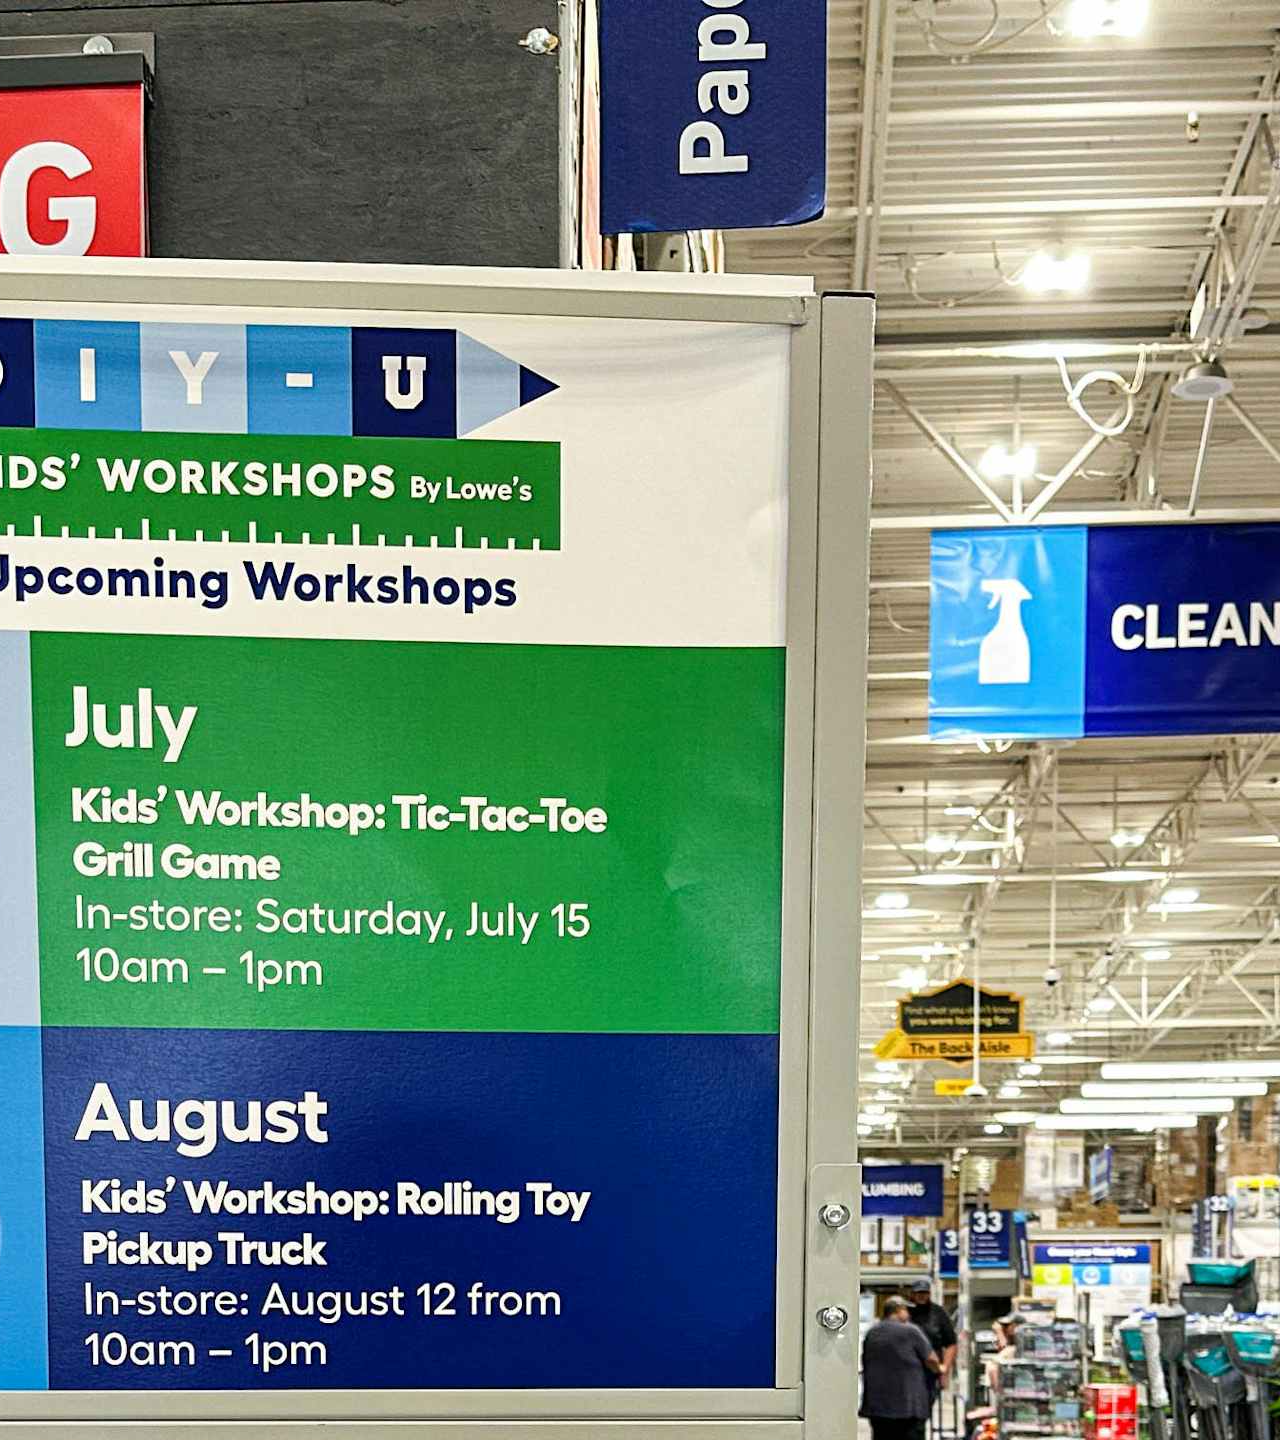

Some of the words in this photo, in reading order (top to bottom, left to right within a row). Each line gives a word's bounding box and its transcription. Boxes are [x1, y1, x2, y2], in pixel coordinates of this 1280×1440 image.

[96, 457, 395, 499] WORKSHOPS
[409, 474, 443, 505] By
[445, 474, 534, 503] Lowe's
[242, 560, 517, 615] Workshops
[65, 685, 198, 763] July
[71, 784, 168, 825] Kids'
[174, 789, 386, 836] Workshop:
[391, 793, 608, 833] Tic-Tac-Toe
[72, 840, 154, 878] Grill
[160, 843, 281, 881] Game
[76, 894, 243, 933] In-store:
[255, 898, 453, 944] Saturday,
[465, 901, 539, 945] July
[550, 903, 590, 938] 15
[76, 947, 189, 983] 10am
[239, 950, 322, 993] 1pm
[910, 1043, 935, 1054] The
[74, 1082, 329, 1158] August
[81, 1175, 177, 1214] Kids'
[182, 1180, 390, 1222] Workshop:
[396, 1180, 520, 1224] Rolling
[525, 1182, 592, 1222] Toy
[972, 1212, 1003, 1233] 33
[83, 1229, 213, 1272] Pickup
[217, 1231, 328, 1266] Truck
[84, 1282, 249, 1316] In-store:
[261, 1282, 405, 1324] August
[416, 1282, 457, 1316] 12
[466, 1281, 561, 1316] from
[84, 1331, 195, 1366] 10am
[244, 1332, 327, 1373] 1pm
